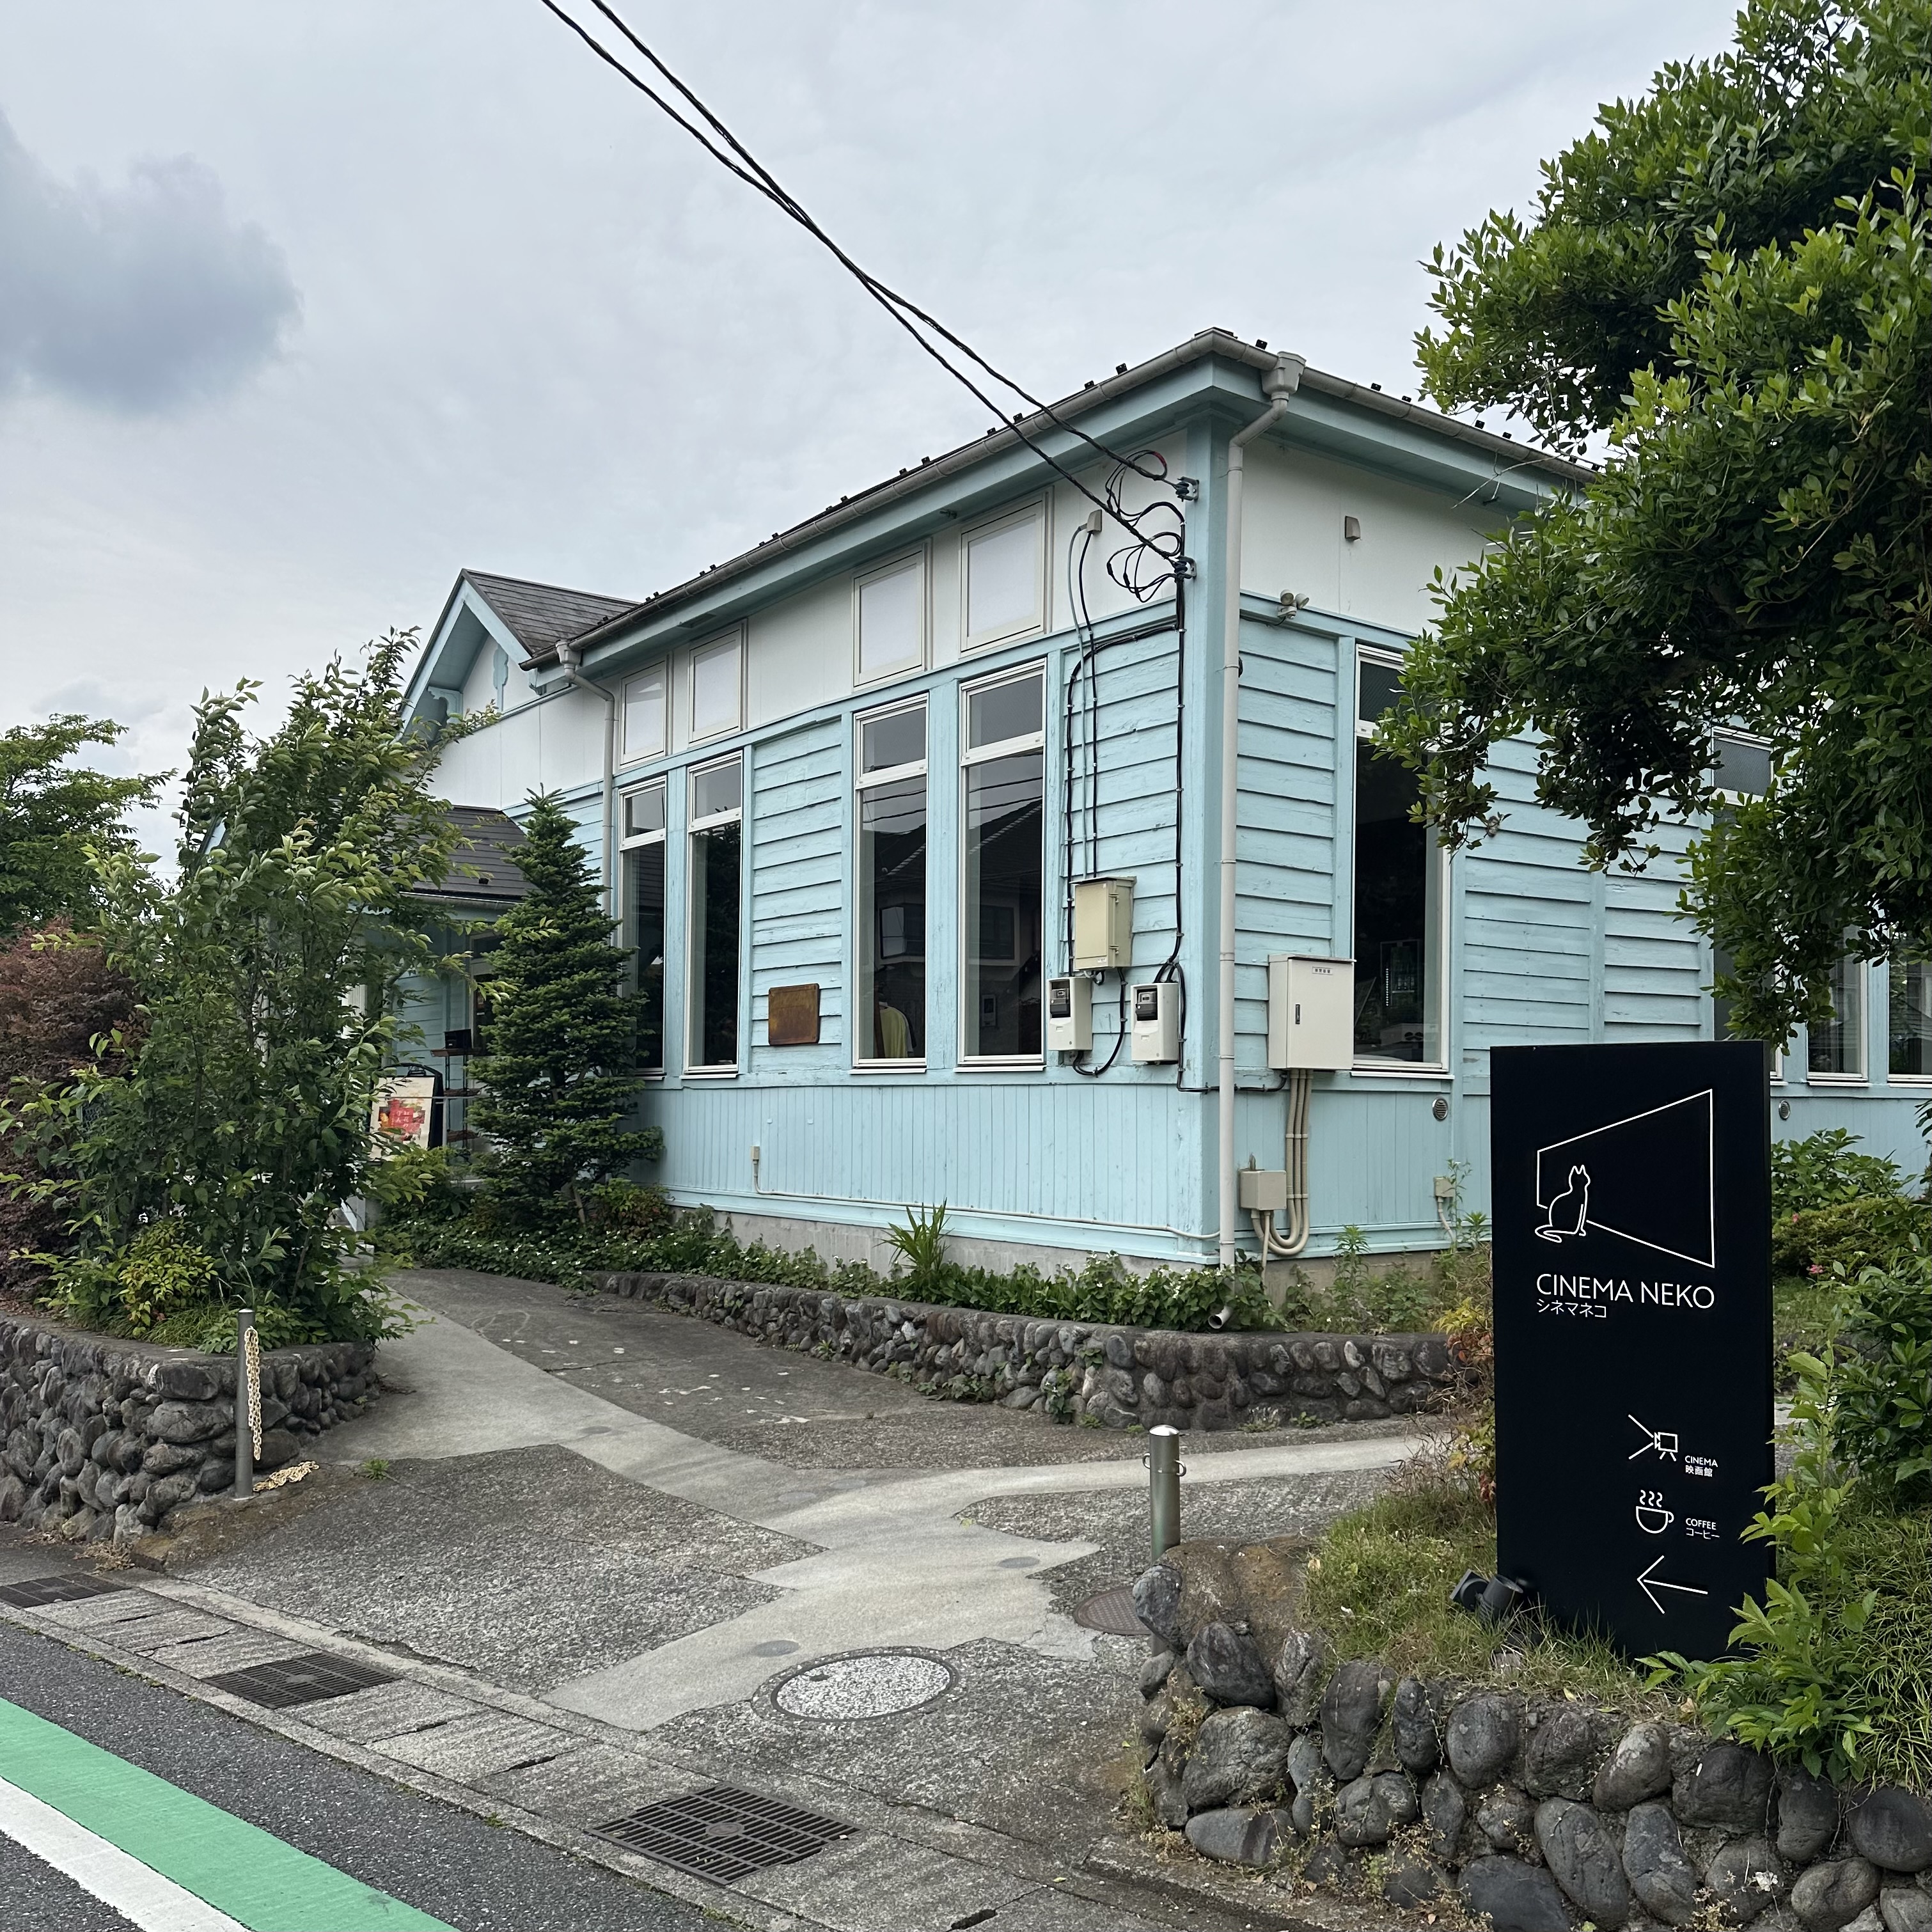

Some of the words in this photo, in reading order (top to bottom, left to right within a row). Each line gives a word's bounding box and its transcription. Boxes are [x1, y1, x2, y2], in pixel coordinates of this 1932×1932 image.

[1537, 1273, 1633, 1302] CINEMA
[1641, 1281, 1715, 1308] NEKO
[1536, 1299, 1606, 1317] シネマネコ
[1685, 1455, 1718, 1467] CINEMA
[1685, 1465, 1713, 1477] 映画館
[1685, 1518, 1716, 1530] COFFEE
[1685, 1528, 1720, 1540] コーヒー
